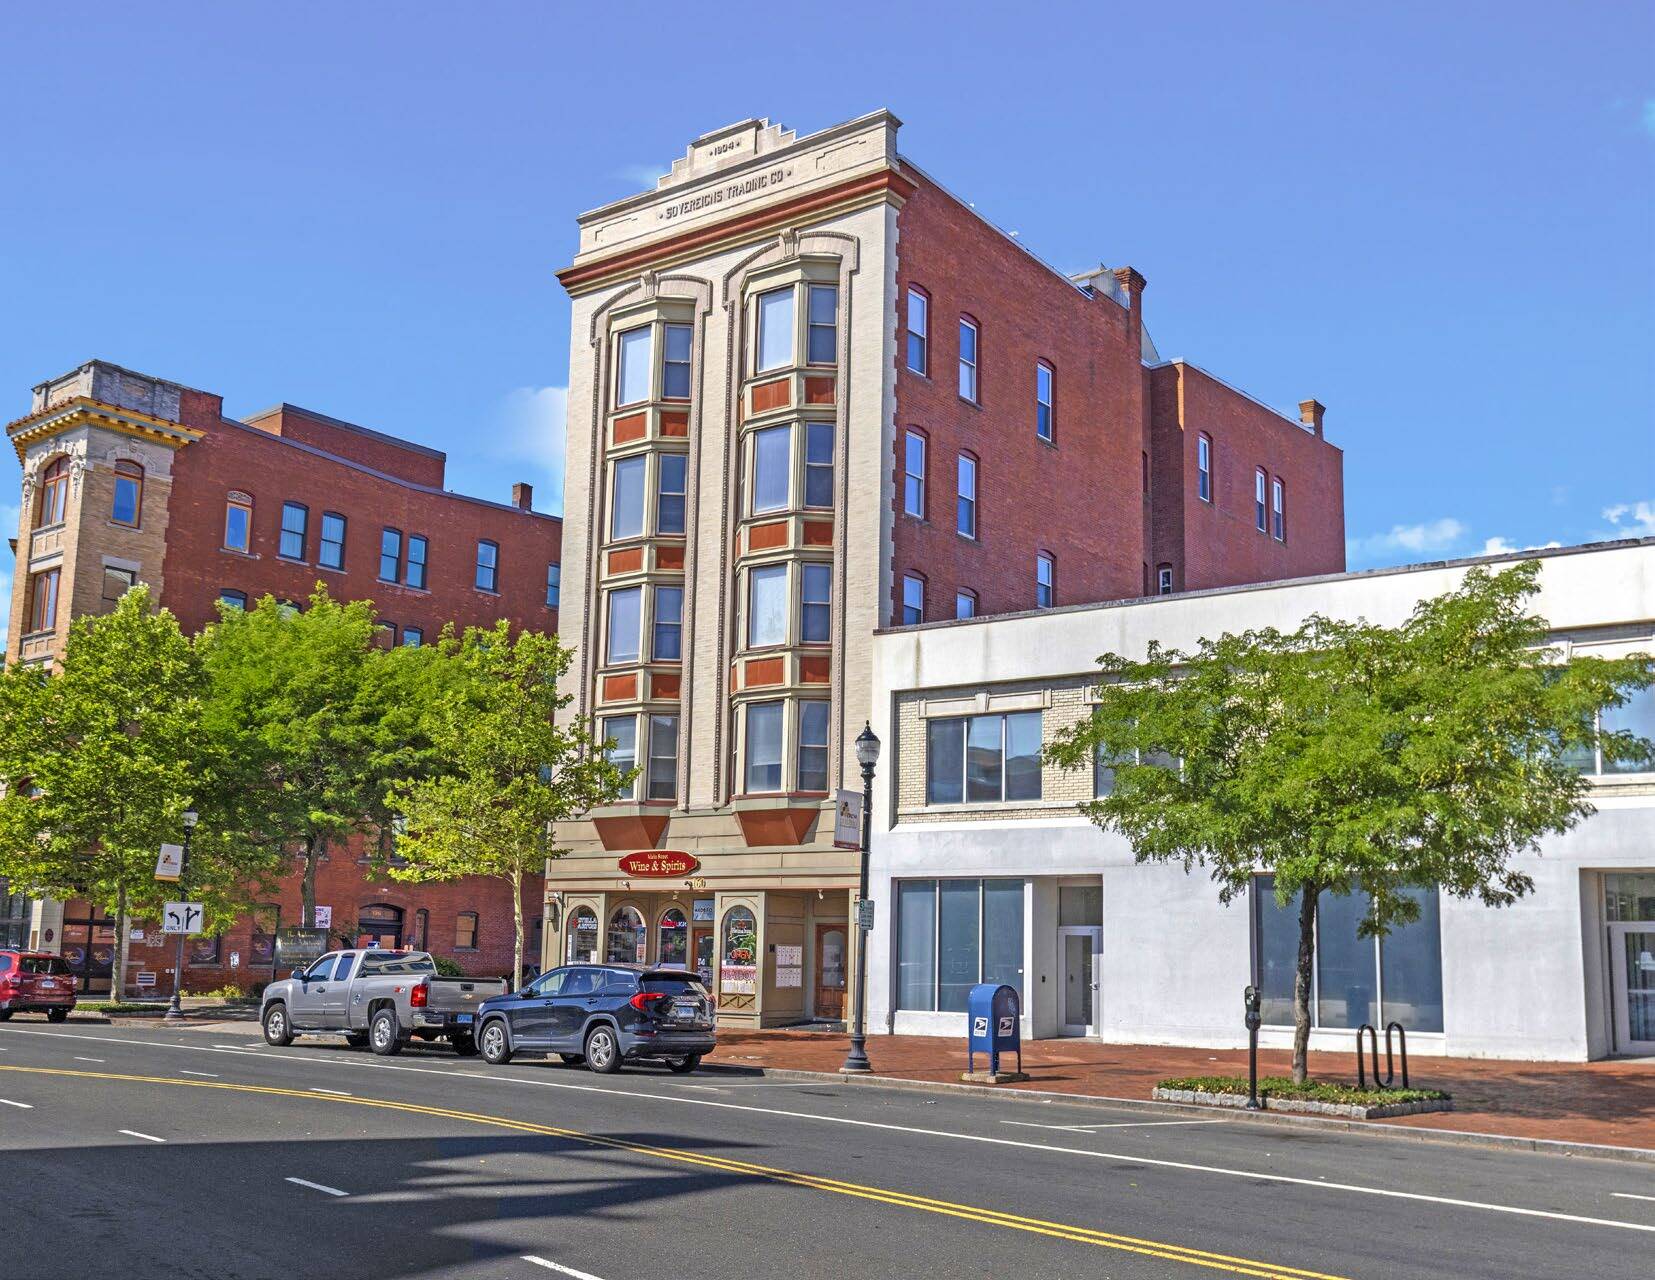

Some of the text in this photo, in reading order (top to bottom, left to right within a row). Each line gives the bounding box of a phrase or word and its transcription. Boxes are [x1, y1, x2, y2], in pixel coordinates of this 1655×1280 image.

[666, 169, 784, 220] SOVEREIGNS TRADING CO
[629, 860, 686, 873] Wine & Spirits
